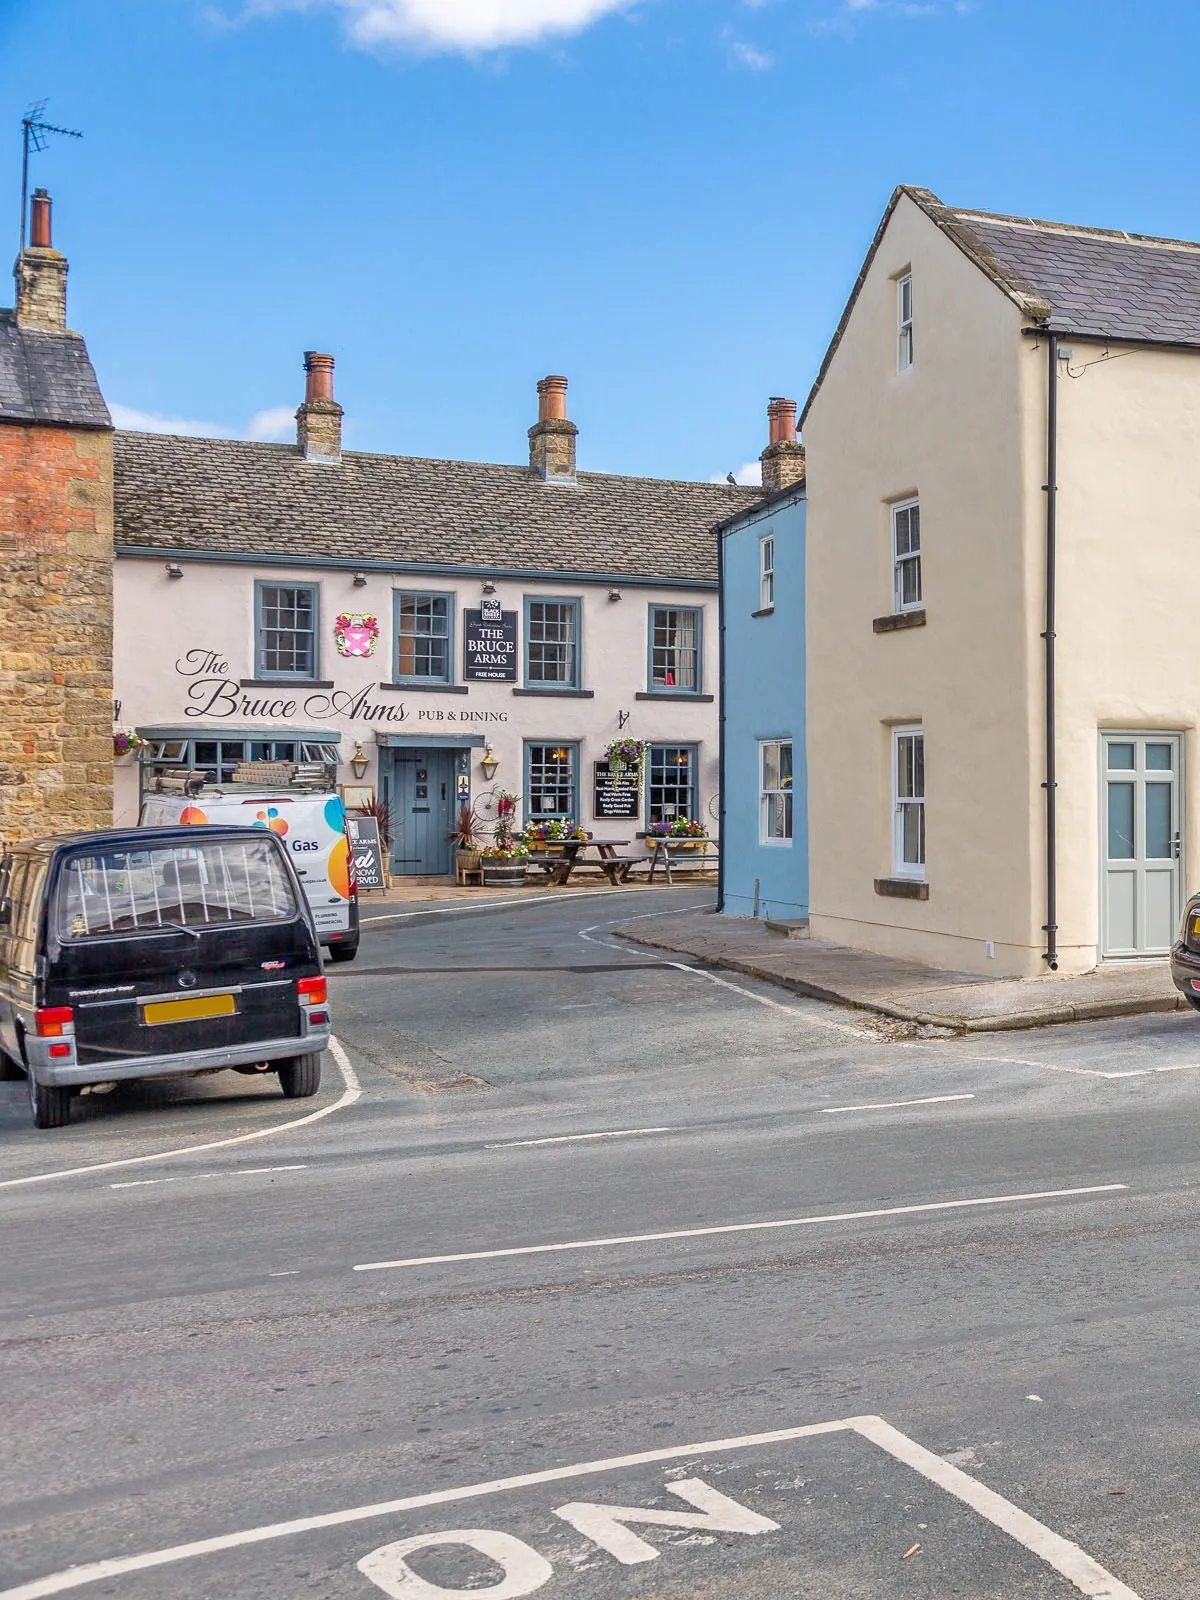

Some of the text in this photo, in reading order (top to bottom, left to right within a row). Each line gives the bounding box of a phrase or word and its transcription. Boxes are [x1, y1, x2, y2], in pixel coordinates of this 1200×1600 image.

[479, 629, 503, 639] THE
[468, 640, 514, 652] BRUCE
[175, 648, 230, 676] The
[474, 653, 507, 664] ARMS
[184, 678, 410, 722] Bruce Arms
[418, 710, 508, 722] PUB & DINING
[292, 840, 319, 851] Gas
